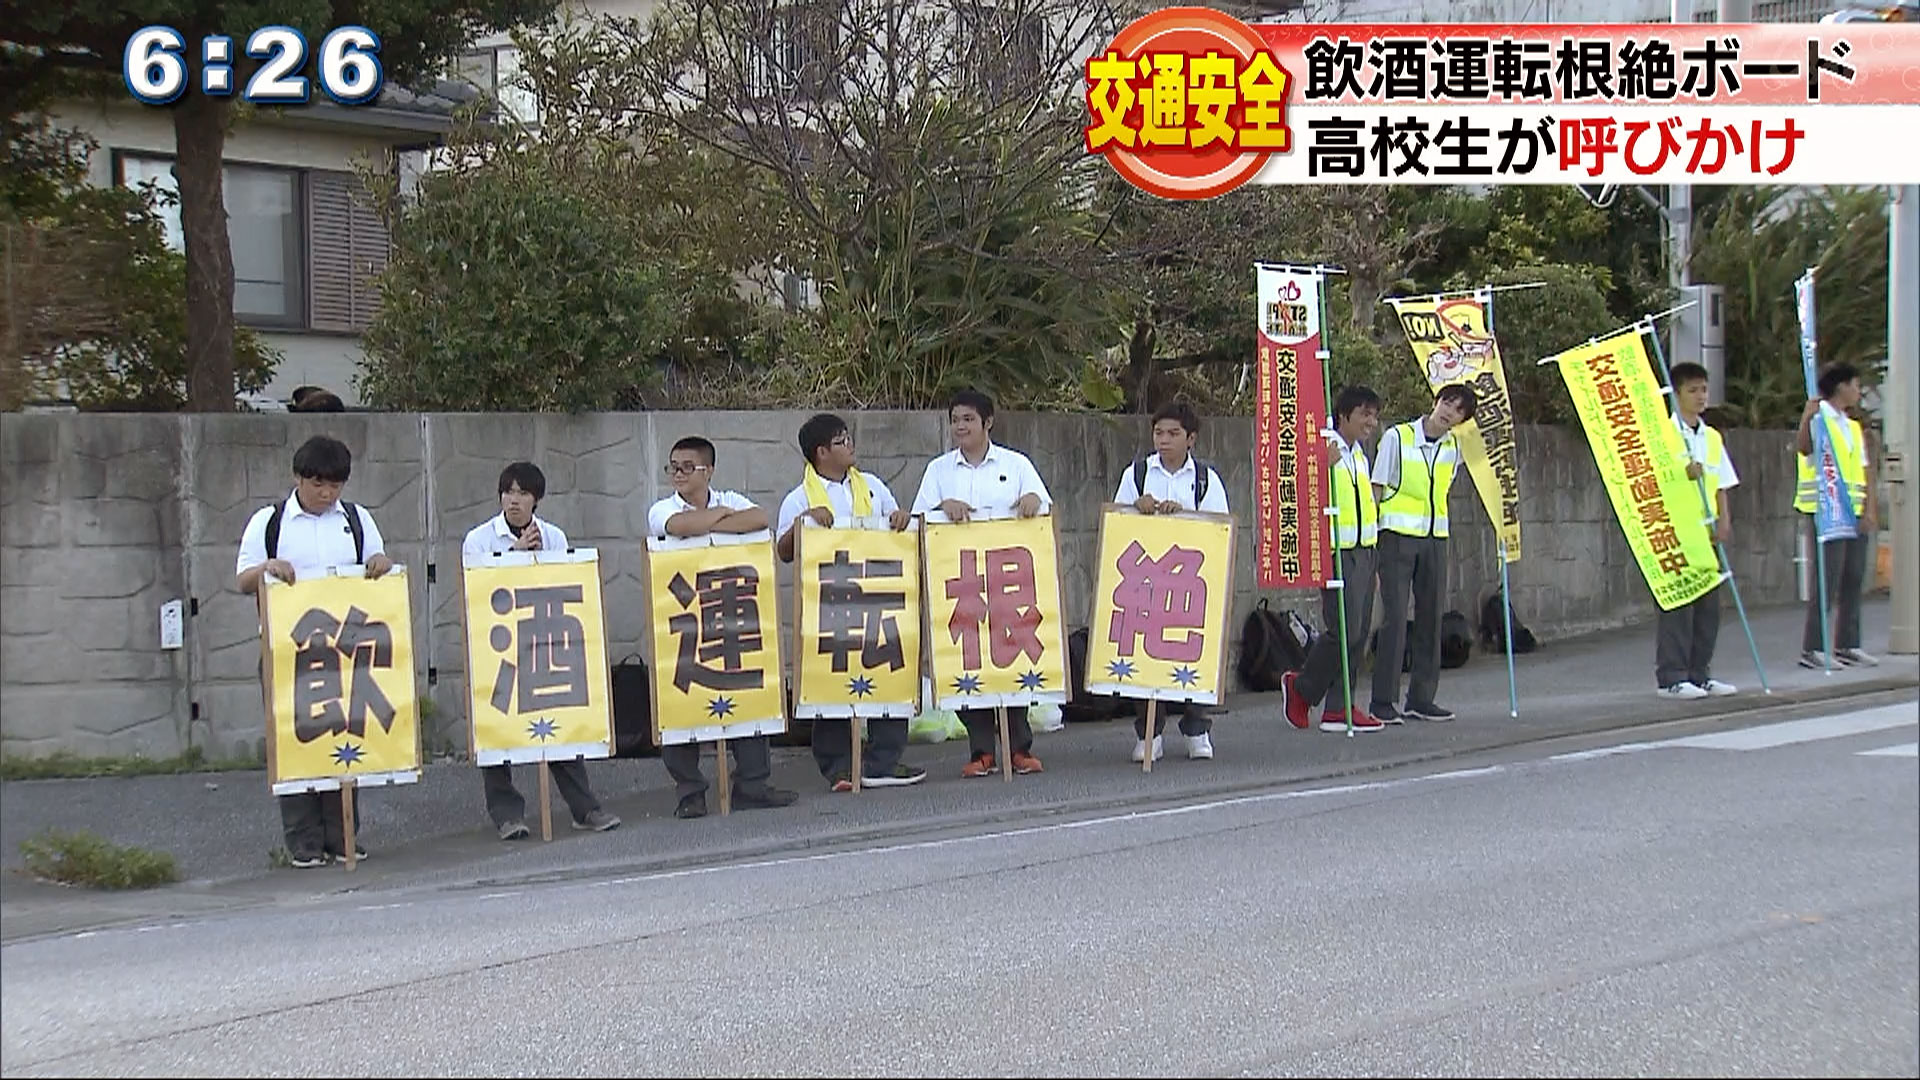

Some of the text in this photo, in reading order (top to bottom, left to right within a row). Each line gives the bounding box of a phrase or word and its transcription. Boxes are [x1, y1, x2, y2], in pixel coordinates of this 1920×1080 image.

[490, 583, 590, 715] 酒
[667, 565, 765, 695] 運
[818, 549, 906, 673] 転
[945, 546, 1045, 671] 根
[1109, 540, 1207, 663] 絶
[290, 605, 397, 744] 飲
